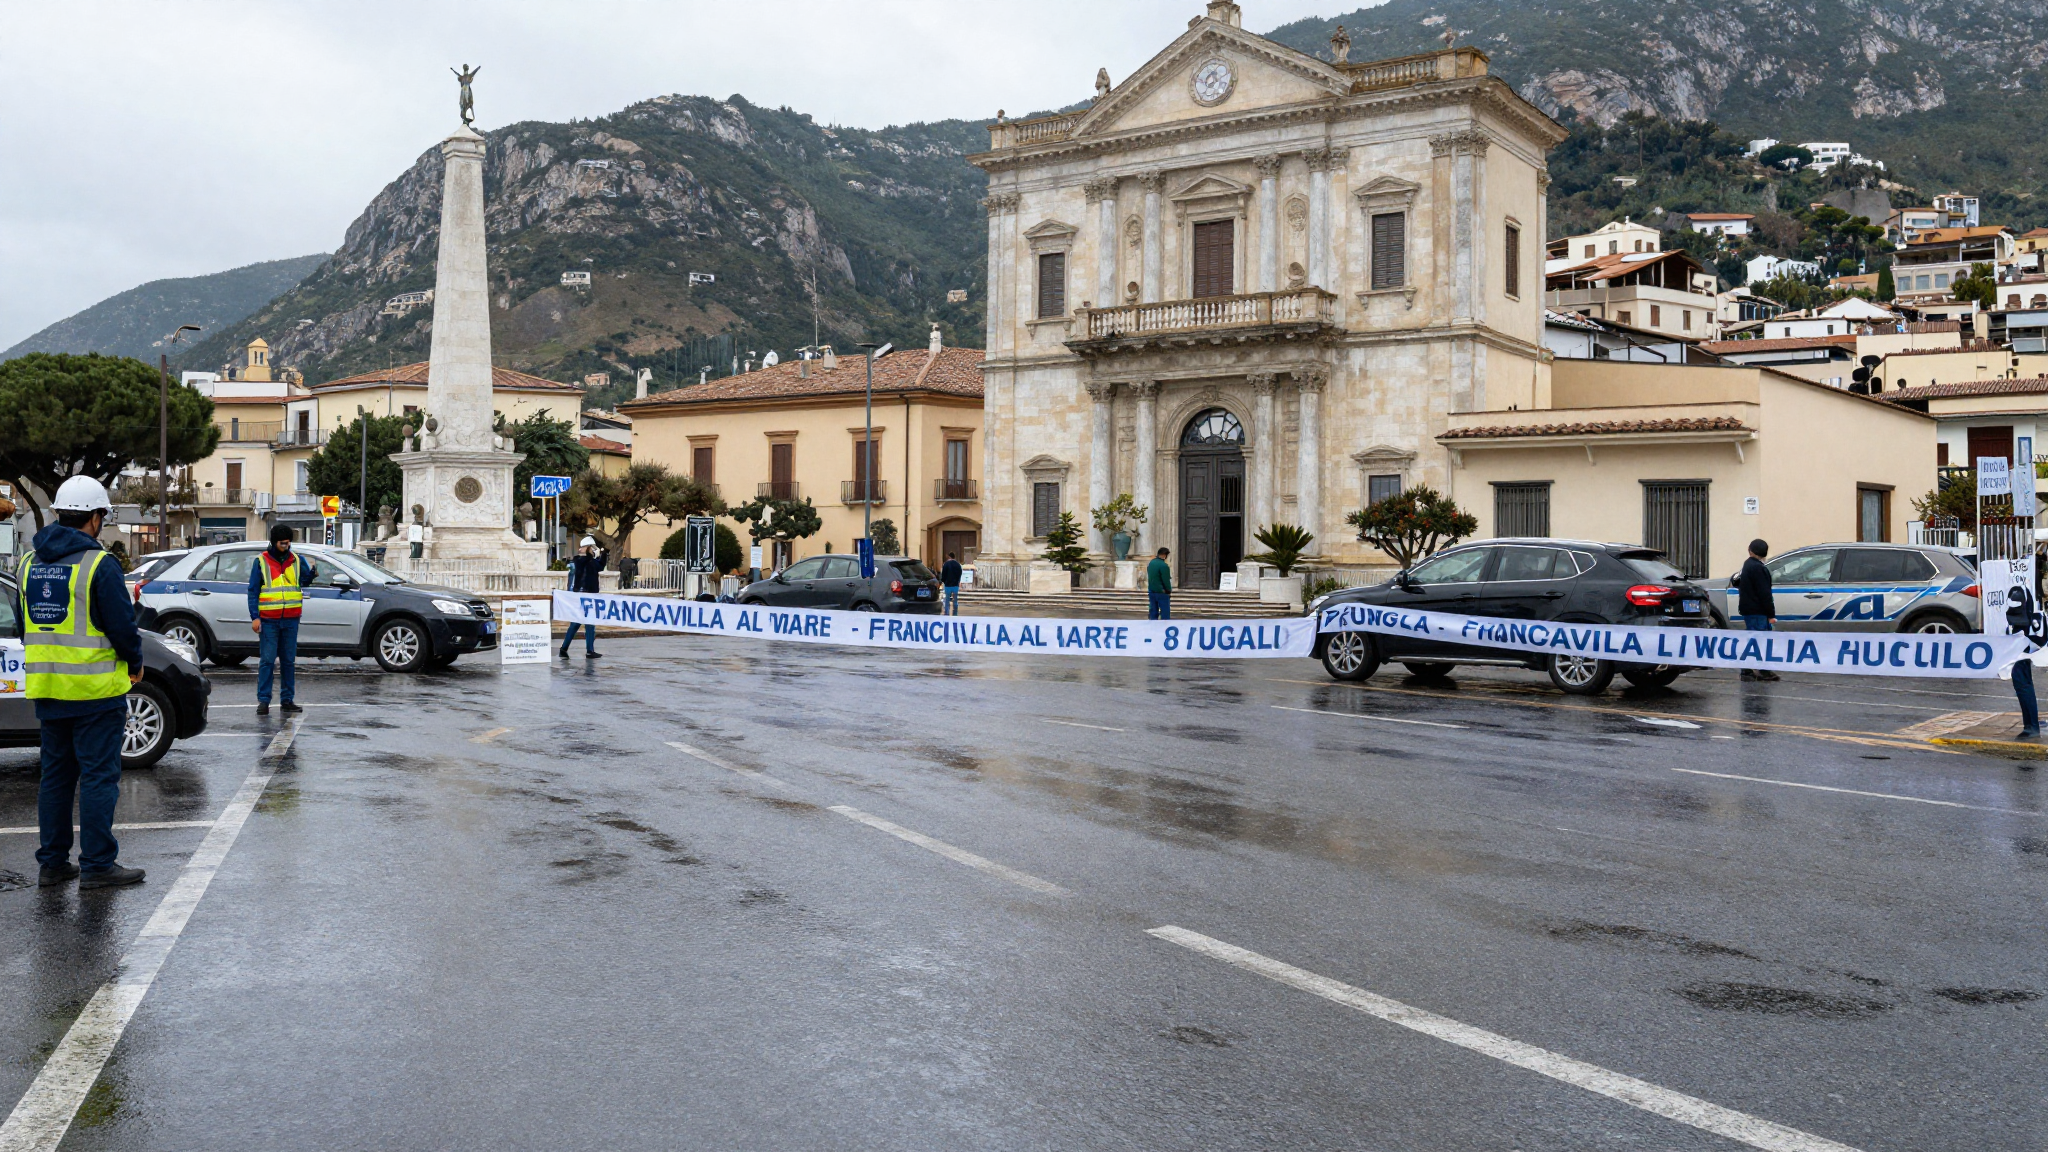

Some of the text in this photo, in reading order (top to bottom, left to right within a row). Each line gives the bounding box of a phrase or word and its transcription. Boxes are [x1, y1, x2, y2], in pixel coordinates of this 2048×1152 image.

[580, 597, 724, 629] FRANCAVILLA
[736, 610, 763, 632] AL
[1018, 624, 1047, 647] AL
